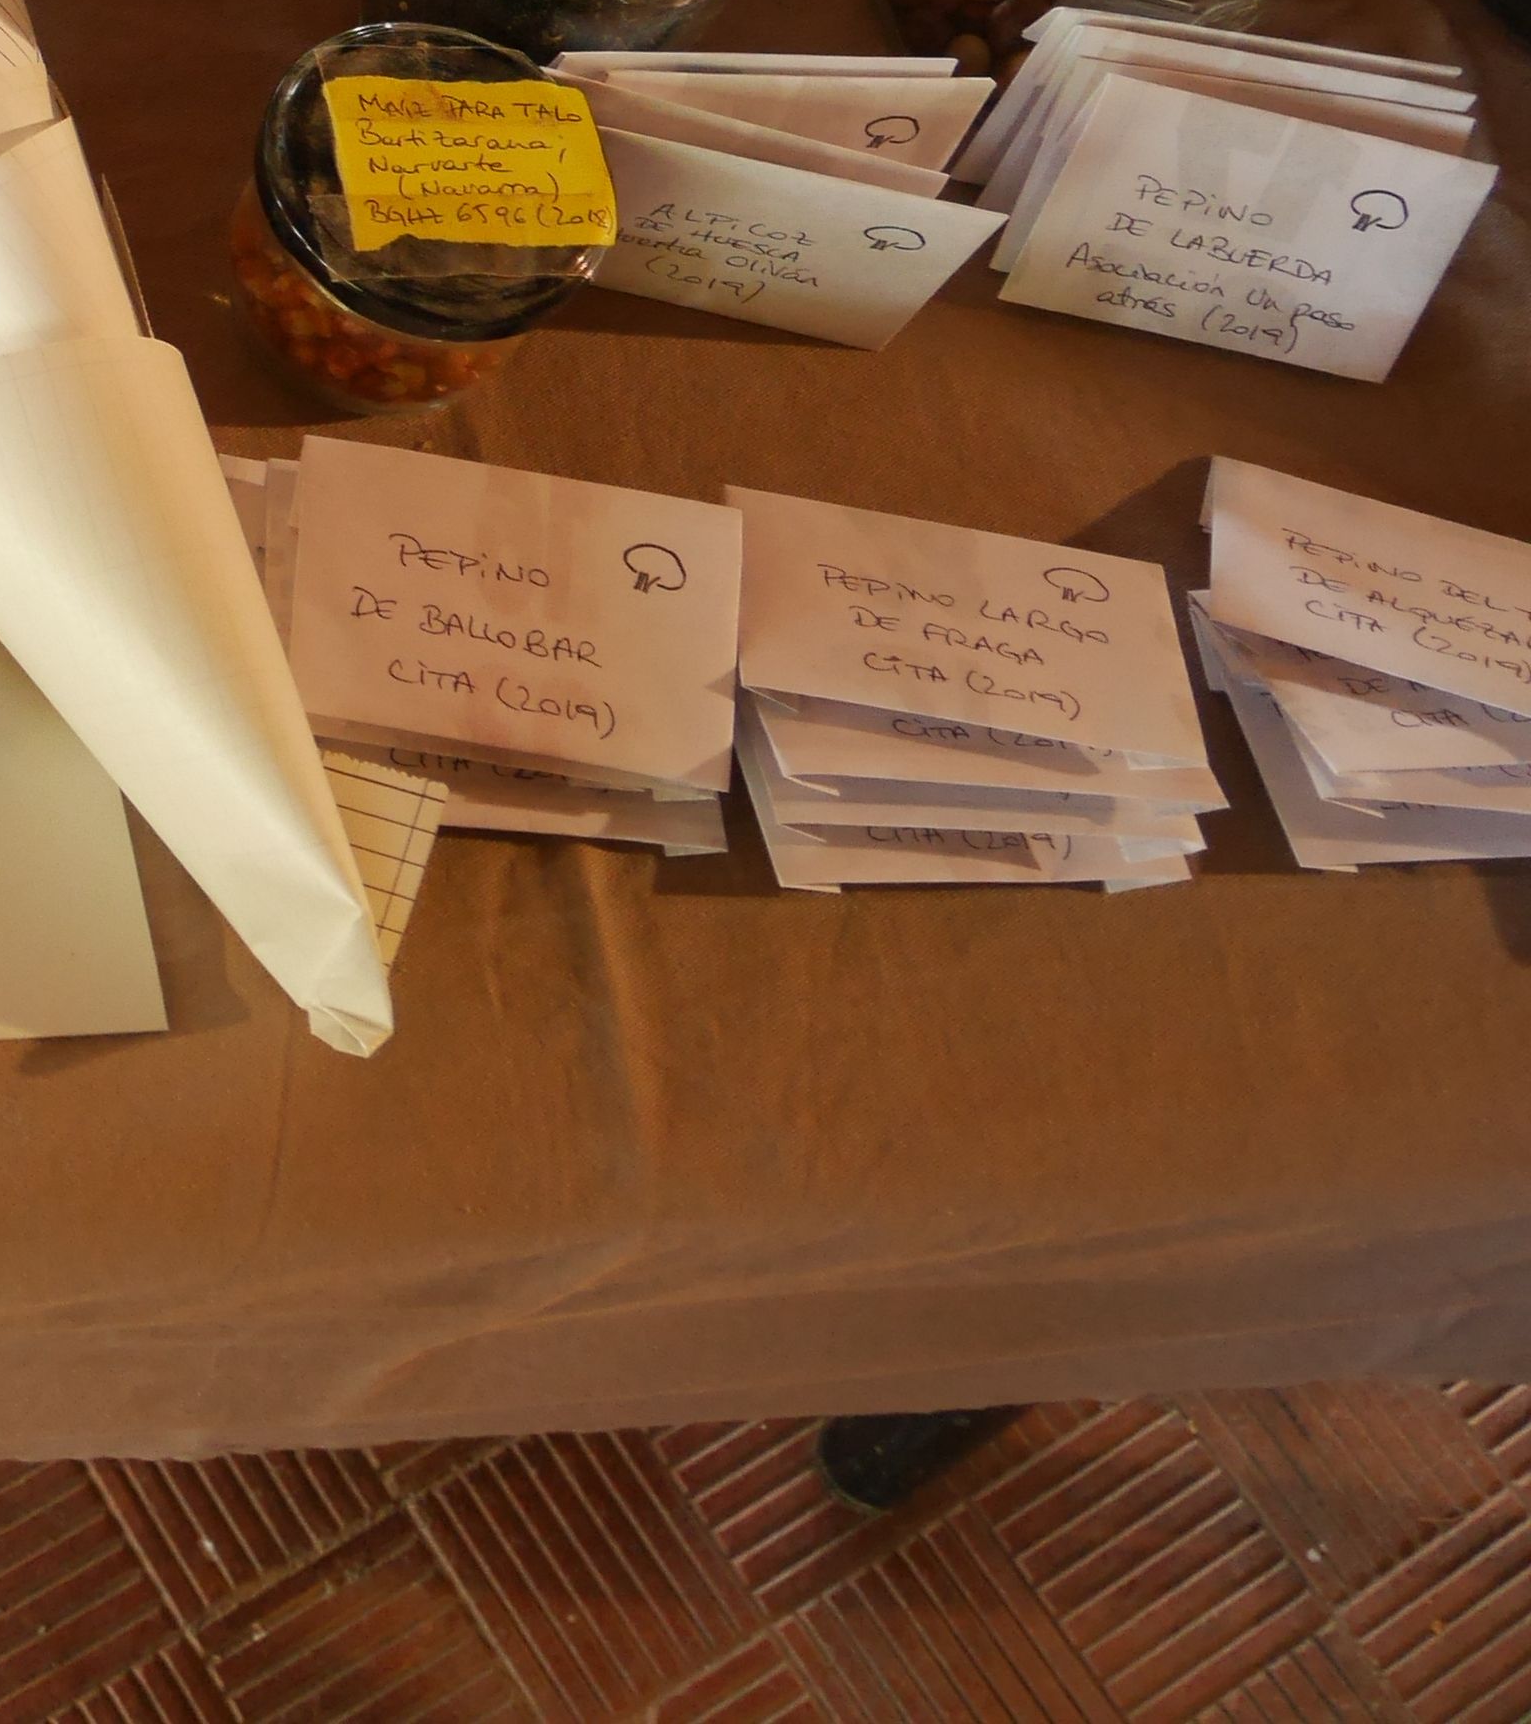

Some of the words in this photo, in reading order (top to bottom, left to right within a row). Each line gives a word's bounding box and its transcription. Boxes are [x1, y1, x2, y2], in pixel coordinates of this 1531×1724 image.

[1108, 212, 1148, 237] DE
[350, 587, 397, 621] DE
[849, 605, 900, 631] DE
